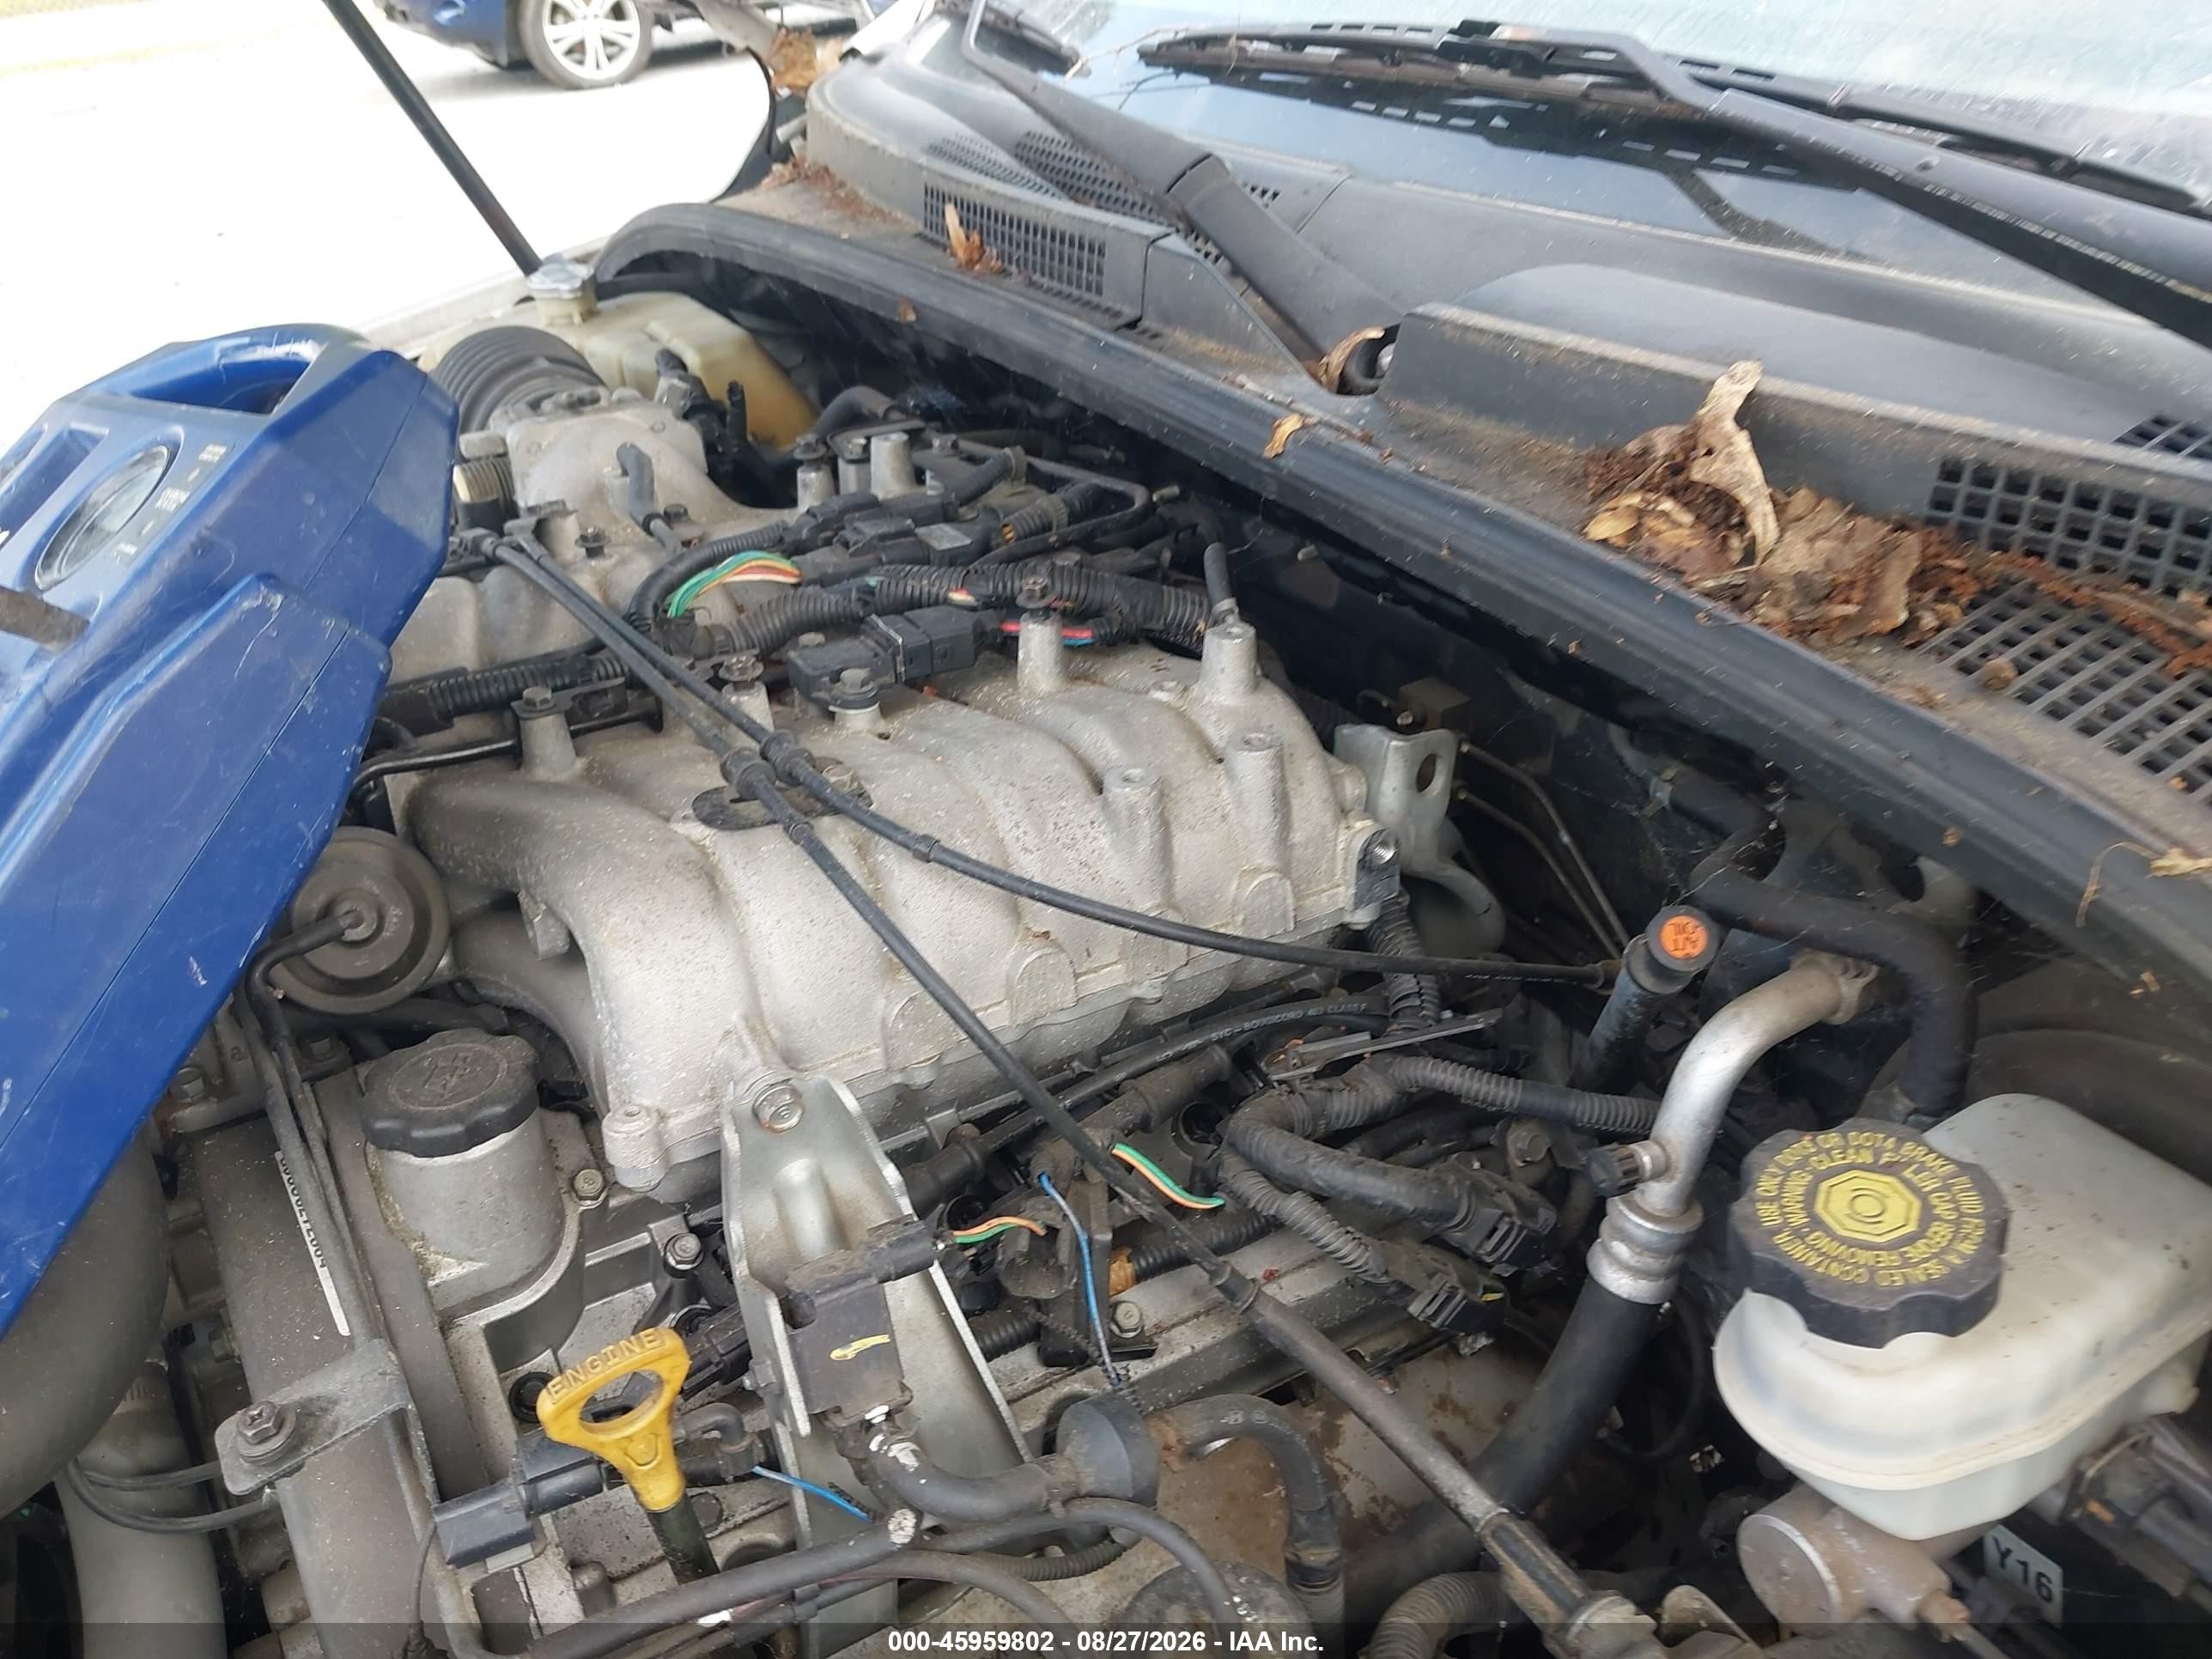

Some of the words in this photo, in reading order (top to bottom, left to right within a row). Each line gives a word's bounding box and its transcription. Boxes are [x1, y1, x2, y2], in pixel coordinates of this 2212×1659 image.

[1816, 1132, 1845, 1149] OR
[1899, 1141, 1959, 1177] BRAKE
[1754, 1164, 1786, 1196] ONLY
[1944, 1176, 1985, 1213] FLUID
[1755, 1201, 1784, 1227] USE
[1928, 1191, 1960, 1220] CAP
[1903, 1221, 1957, 1263] BEFORE
[1874, 1258, 1952, 1286] SEALED
[547, 1330, 667, 1405] ENGINE
[1991, 1535, 2053, 1604] Y16
